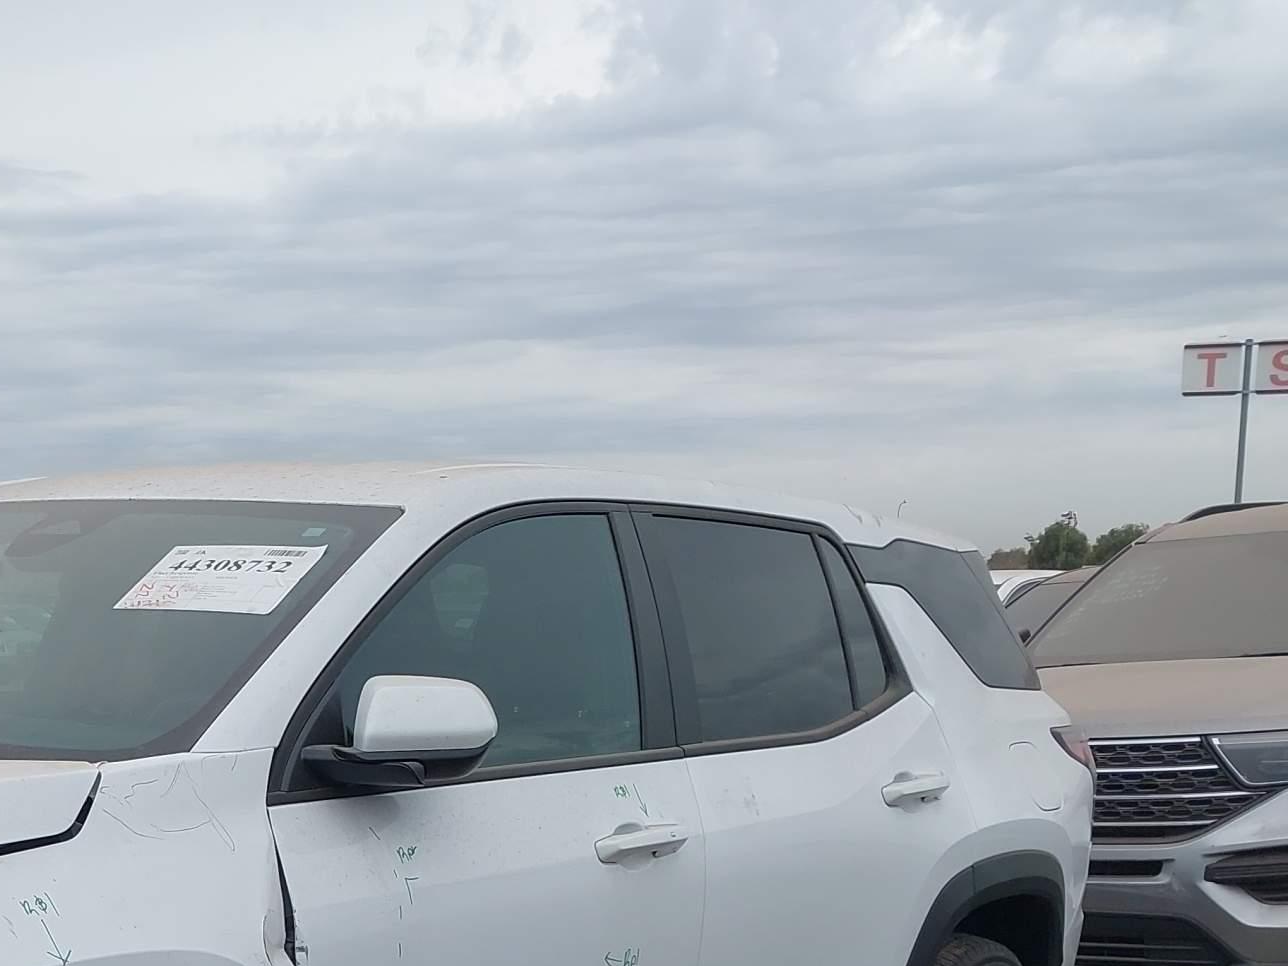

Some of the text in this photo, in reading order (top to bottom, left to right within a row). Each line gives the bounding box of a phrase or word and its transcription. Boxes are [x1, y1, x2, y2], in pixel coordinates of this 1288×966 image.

[1197, 352, 1227, 388] T
[1269, 349, 1288, 387] S
[169, 559, 293, 573] 44308732
